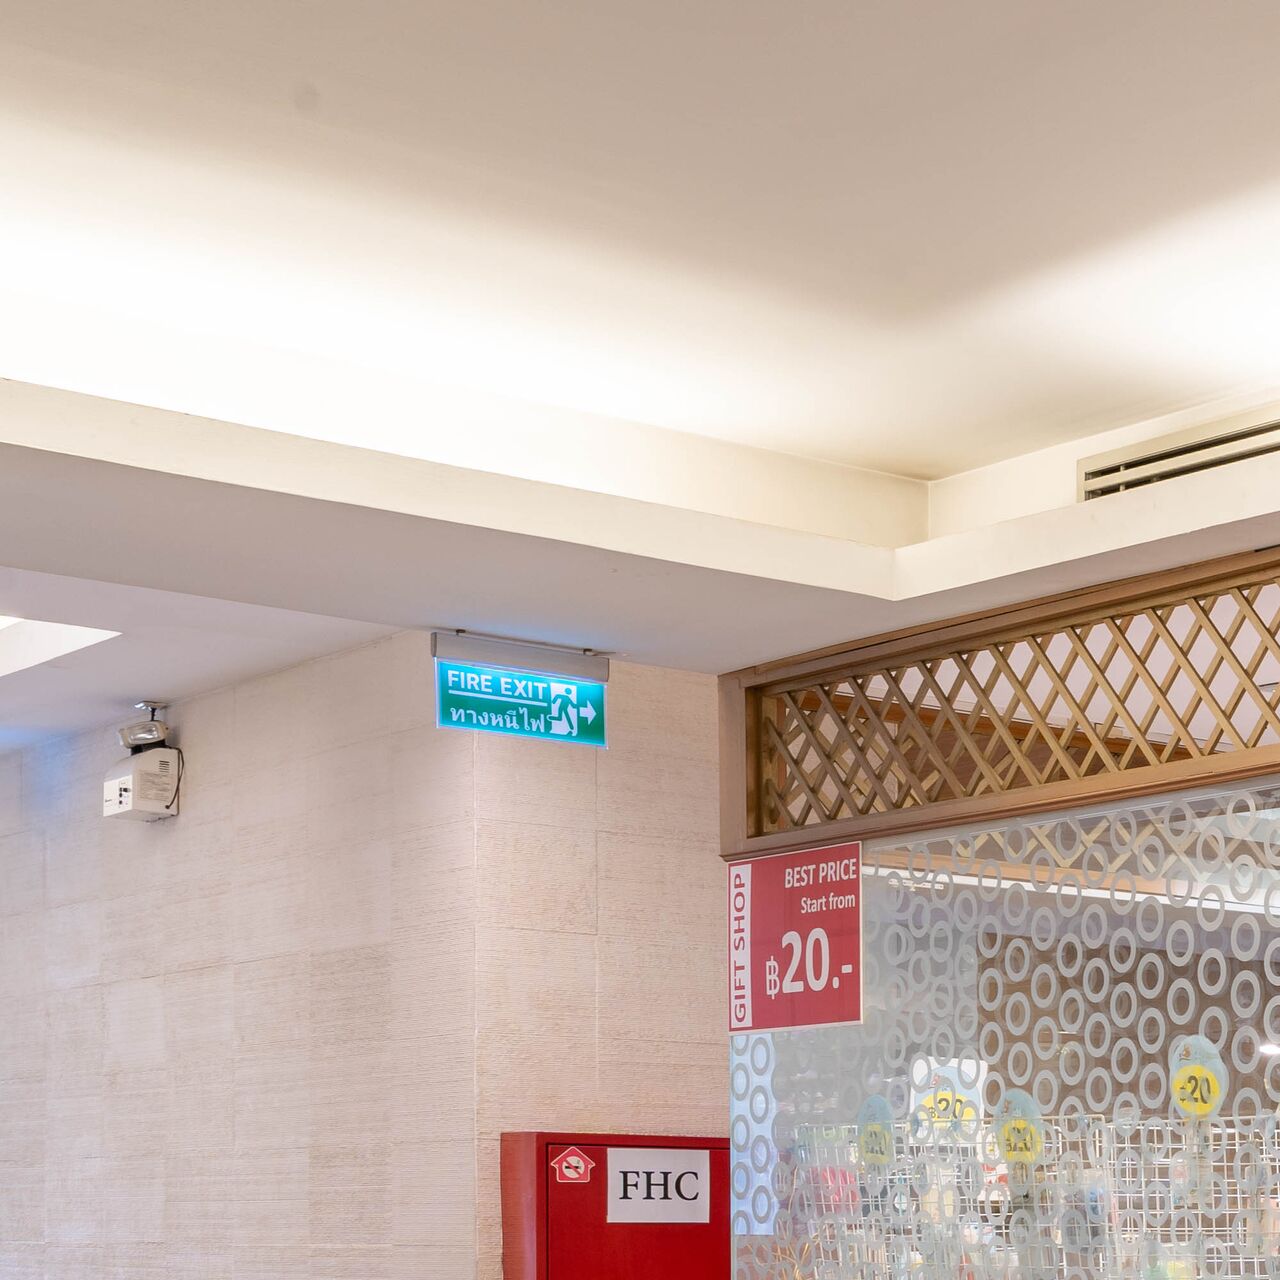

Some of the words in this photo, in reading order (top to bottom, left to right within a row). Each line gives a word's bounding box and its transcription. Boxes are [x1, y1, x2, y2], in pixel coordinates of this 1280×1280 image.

[447, 669, 492, 693] FIRE
[500, 677, 548, 700] EXIT
[450, 706, 545, 733] ทางหนีไฟ
[784, 863, 816, 889] BEST
[819, 858, 857, 884] PRICE
[733, 873, 746, 951] SHOP
[800, 896, 827, 914] Start
[829, 892, 856, 912] from
[733, 960, 747, 1023] GIFT
[618, 1170, 700, 1201] FHC
